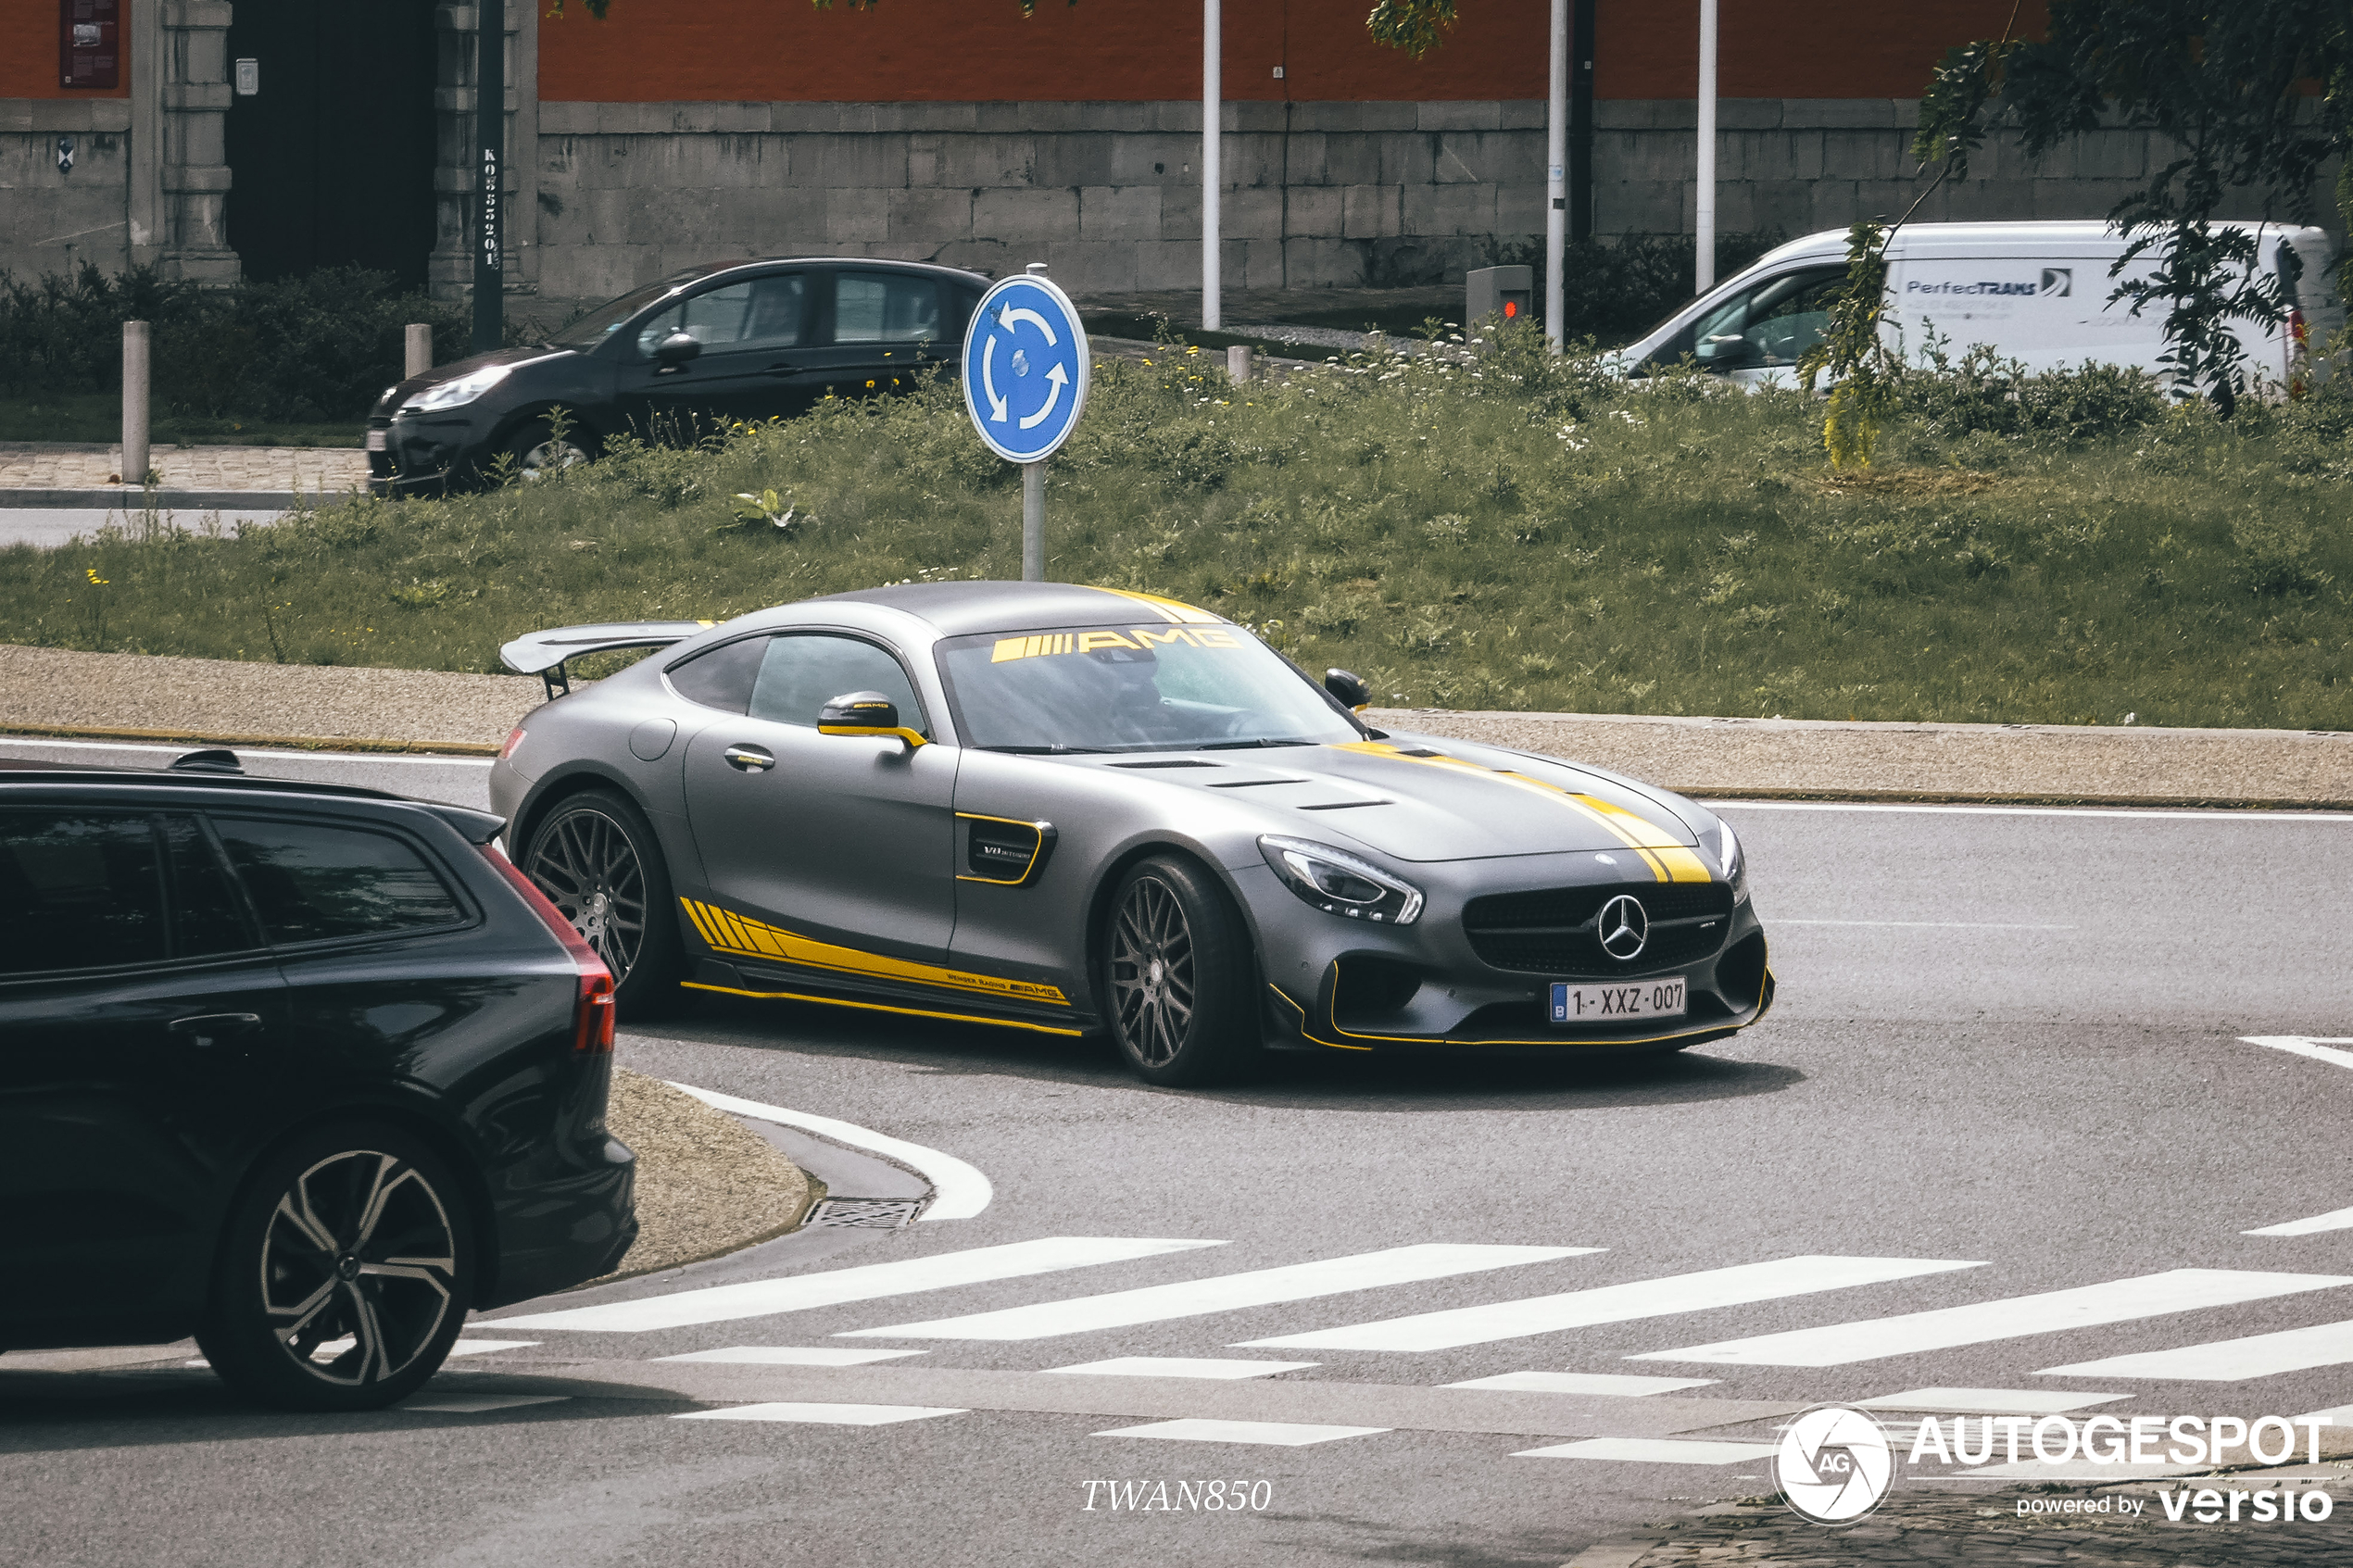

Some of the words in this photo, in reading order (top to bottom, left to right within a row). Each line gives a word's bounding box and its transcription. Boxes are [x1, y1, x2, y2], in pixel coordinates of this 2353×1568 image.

[1078, 628, 1245, 654] AMG
[1023, 985, 1058, 998] AMG
[1555, 1005, 1565, 1018] B
